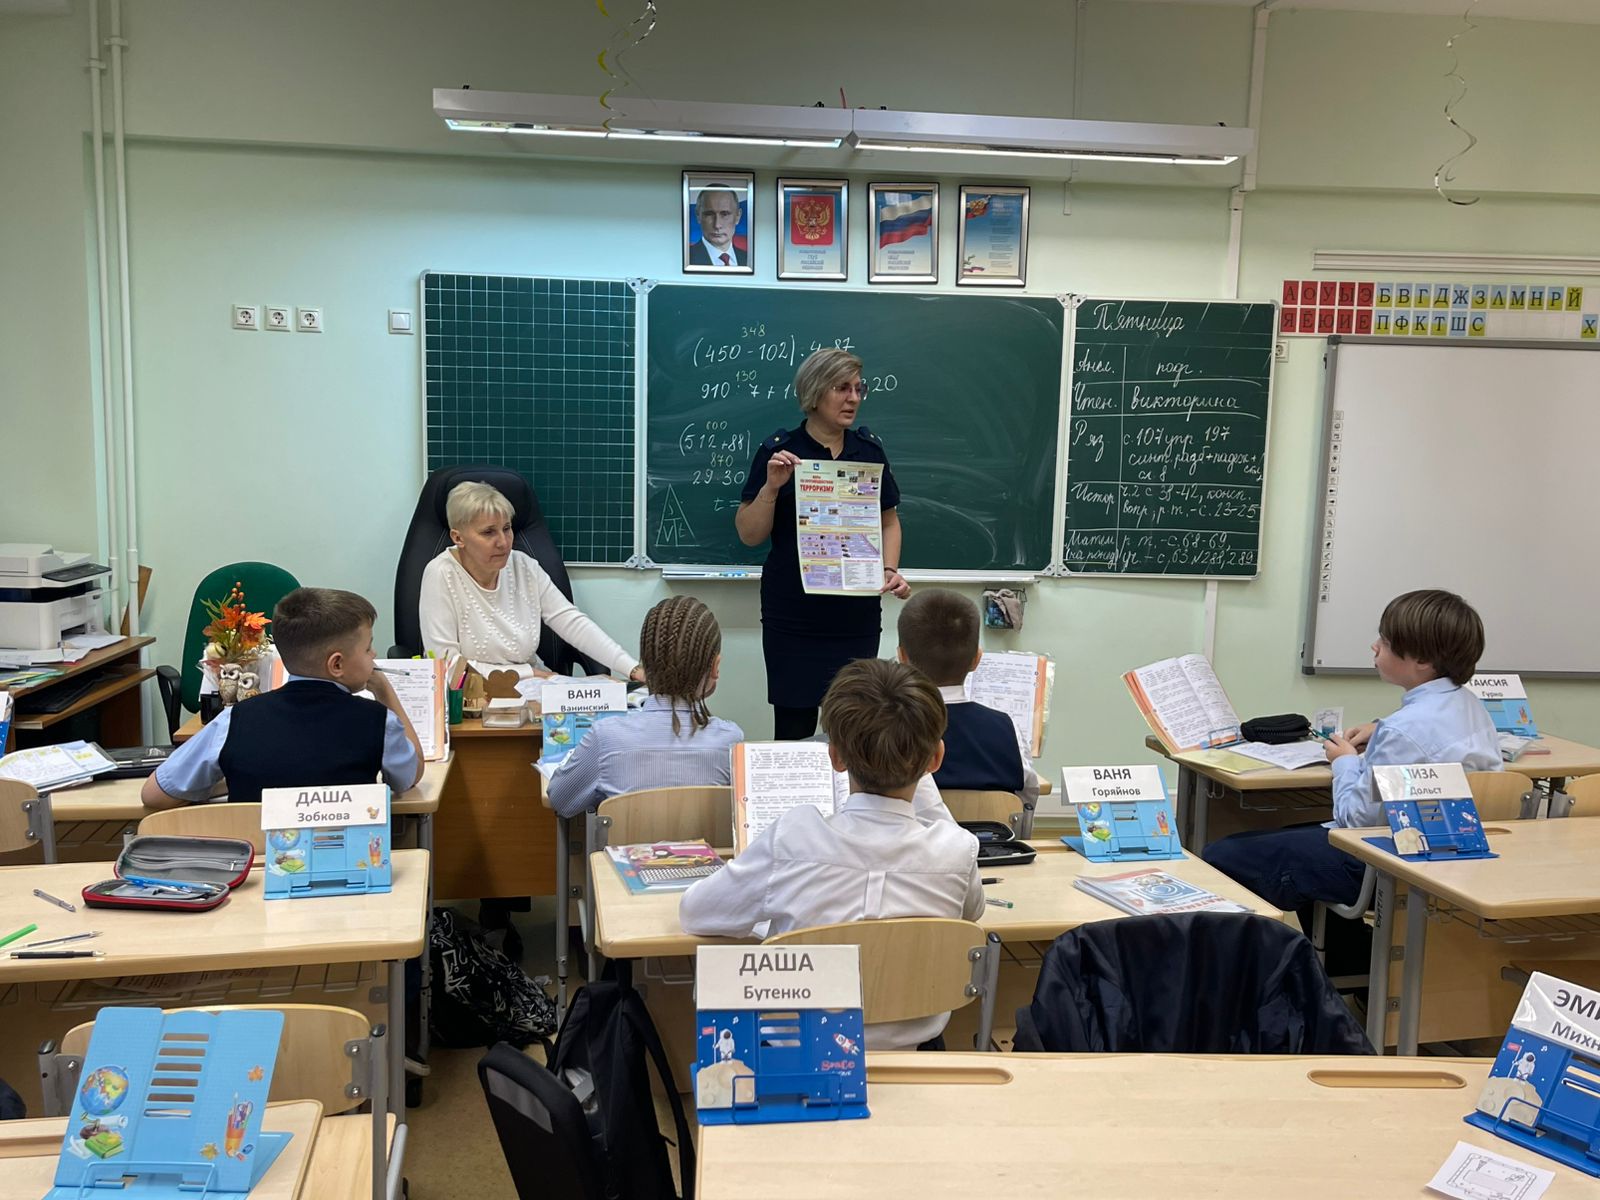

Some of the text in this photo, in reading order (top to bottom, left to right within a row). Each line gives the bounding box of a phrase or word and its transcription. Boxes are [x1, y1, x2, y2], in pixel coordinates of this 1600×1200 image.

[1093, 303, 1185, 338] Пятница
[741, 324, 766, 338] 348
[735, 369, 757, 382] 130
[701, 382, 730, 399] 910
[1130, 386, 1241, 422] викторина
[1204, 425, 1231, 442] 197
[710, 452, 734, 468] 870
[567, 689, 602, 700] ВАНЯ
[560, 703, 610, 713] Ванинский
[1093, 768, 1132, 780] ВАНЯ
[296, 790, 353, 808] ДАША
[1092, 786, 1141, 797] Горяйнов
[297, 811, 350, 822] Зобкова
[739, 953, 815, 977] ДАША
[743, 985, 812, 1002] Бутенко
